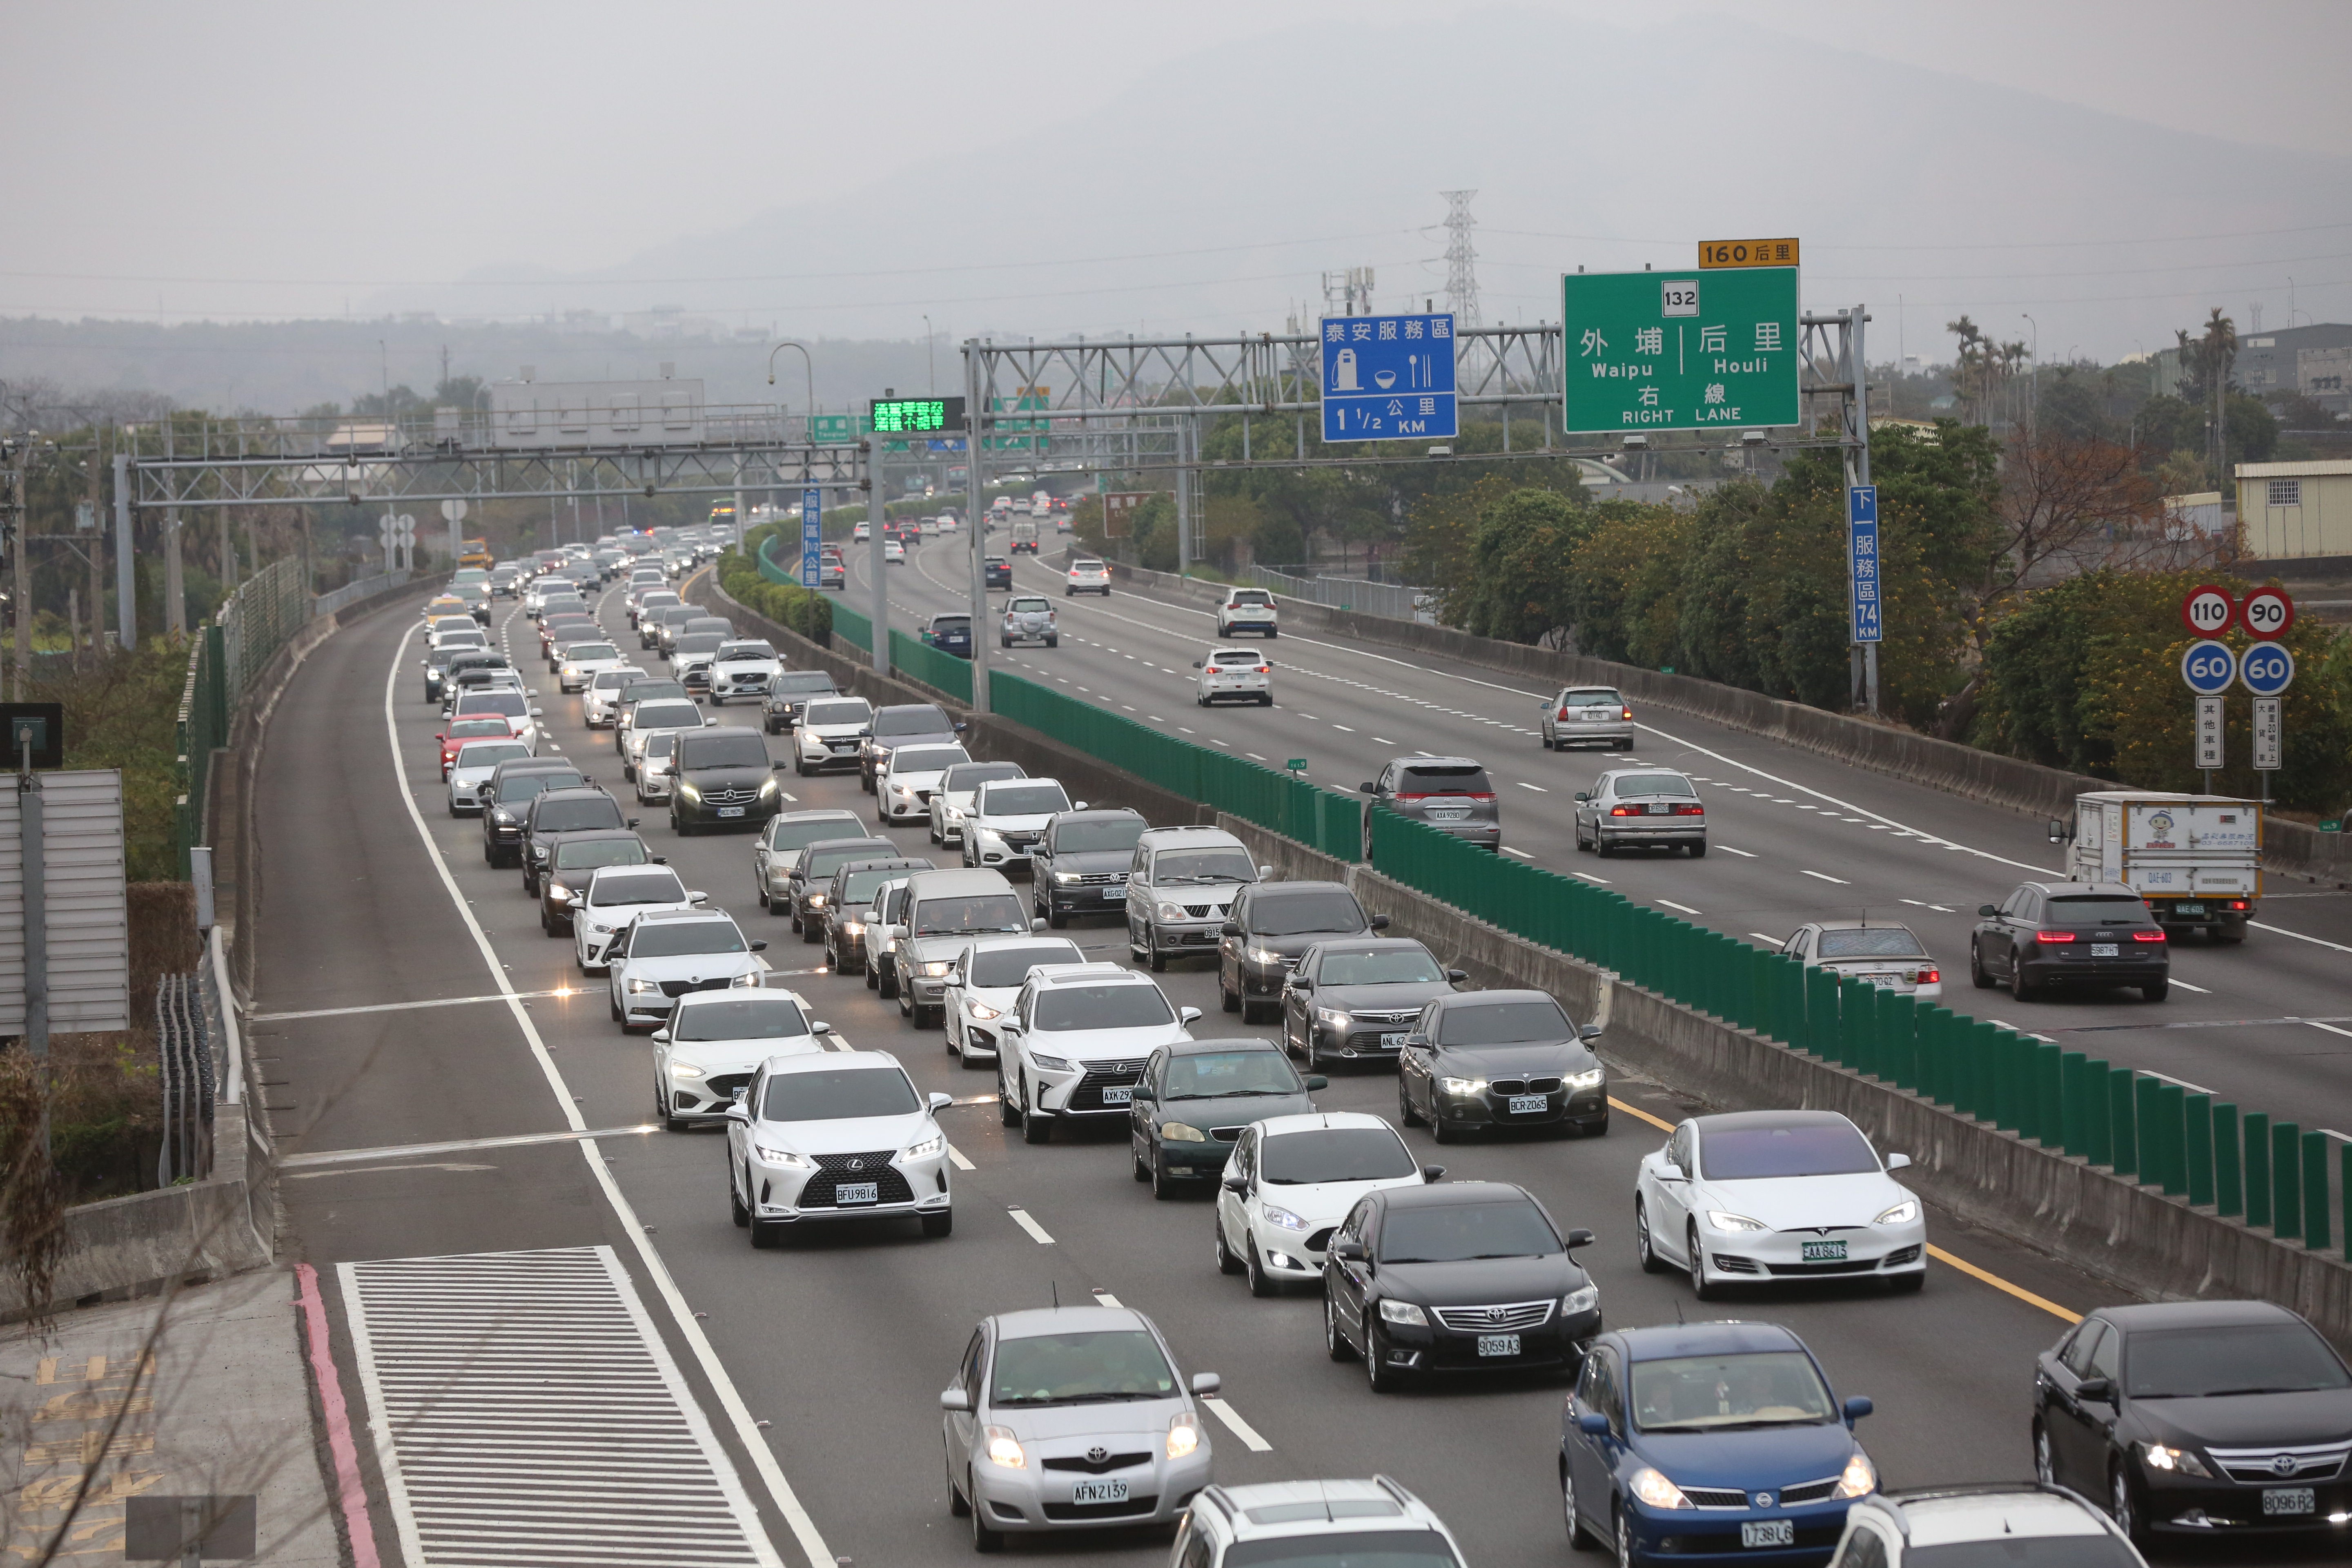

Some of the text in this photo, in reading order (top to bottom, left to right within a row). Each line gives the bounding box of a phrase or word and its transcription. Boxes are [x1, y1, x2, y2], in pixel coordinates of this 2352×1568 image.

[1707, 245, 1791, 263] 160 后里
[1666, 292, 1695, 306] 132
[1326, 318, 1450, 343] 泰安服務區
[1699, 323, 1783, 353] 后里
[1581, 327, 1663, 357] 外埔
[1592, 363, 1653, 381] Waipu
[1715, 358, 1767, 374] Houli
[1639, 383, 1726, 406] 右線
[1388, 398, 1436, 416] 公里
[1623, 408, 1742, 424] RIGHT LANE
[1338, 409, 1345, 430] 1
[1399, 420, 1425, 434] KM
[1853, 490, 1878, 638] 下一服務區 74 KM
[2194, 603, 2225, 621] 110
[2252, 604, 2282, 623] 90
[2192, 657, 2227, 678] 60
[2249, 658, 2285, 679] 60
[2204, 705, 2216, 760] 其他車種
[2258, 705, 2266, 762] 大貨車
[2149, 873, 2172, 883] QAE-603
